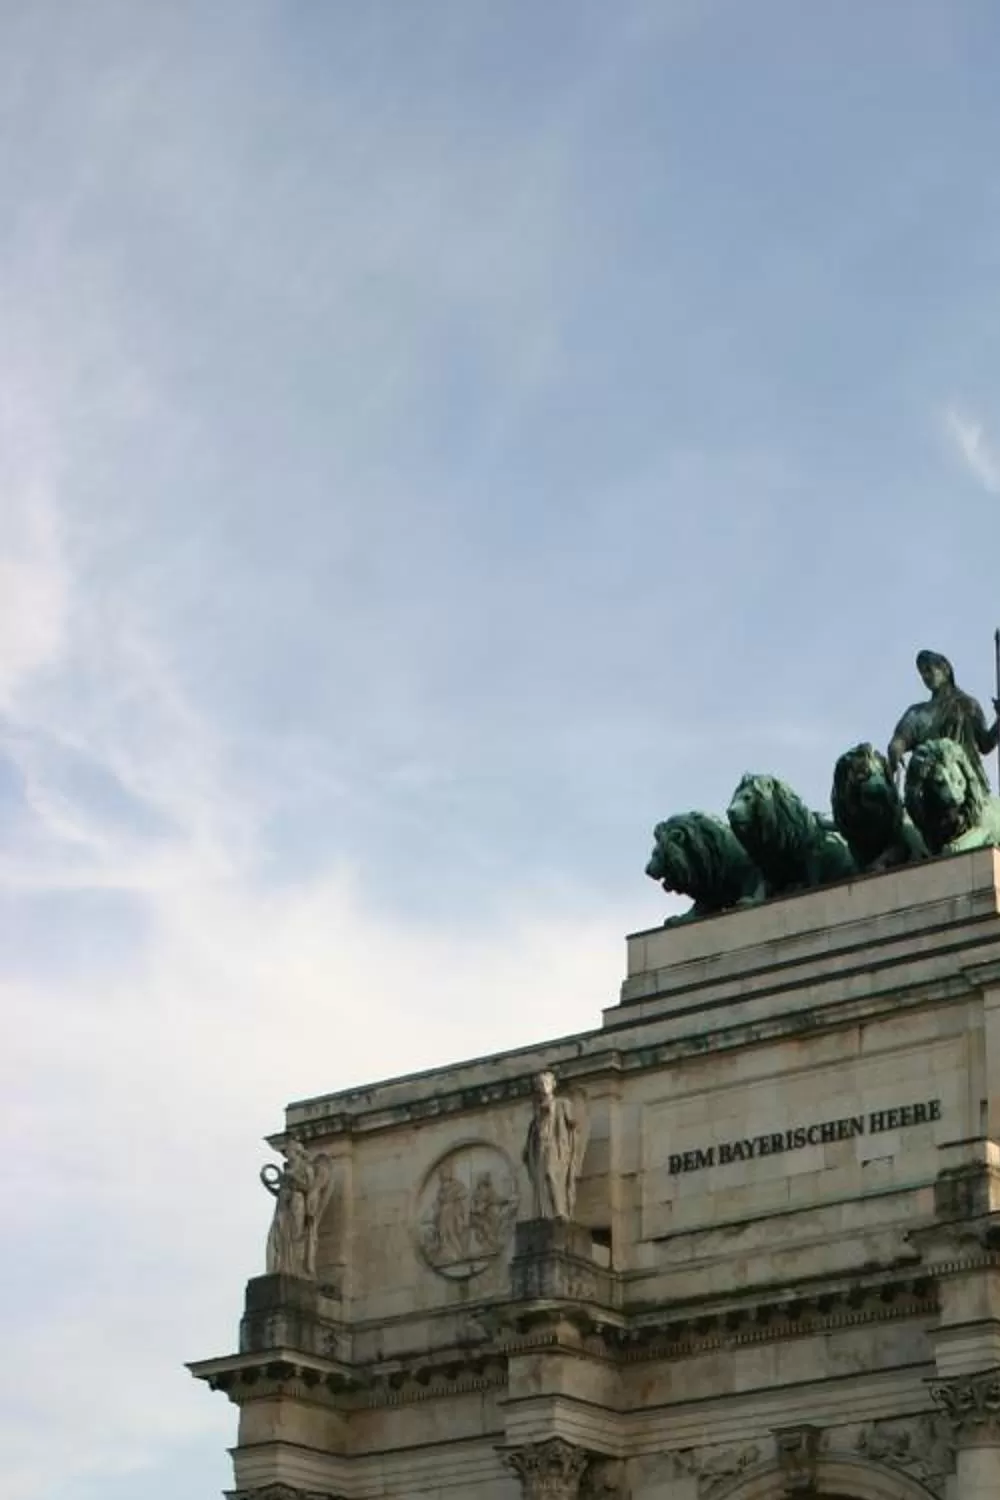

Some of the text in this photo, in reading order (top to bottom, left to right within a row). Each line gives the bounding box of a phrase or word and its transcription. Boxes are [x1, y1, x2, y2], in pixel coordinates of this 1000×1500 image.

[668, 1099, 941, 1175] DEM BAYERISCHEN HEERE
